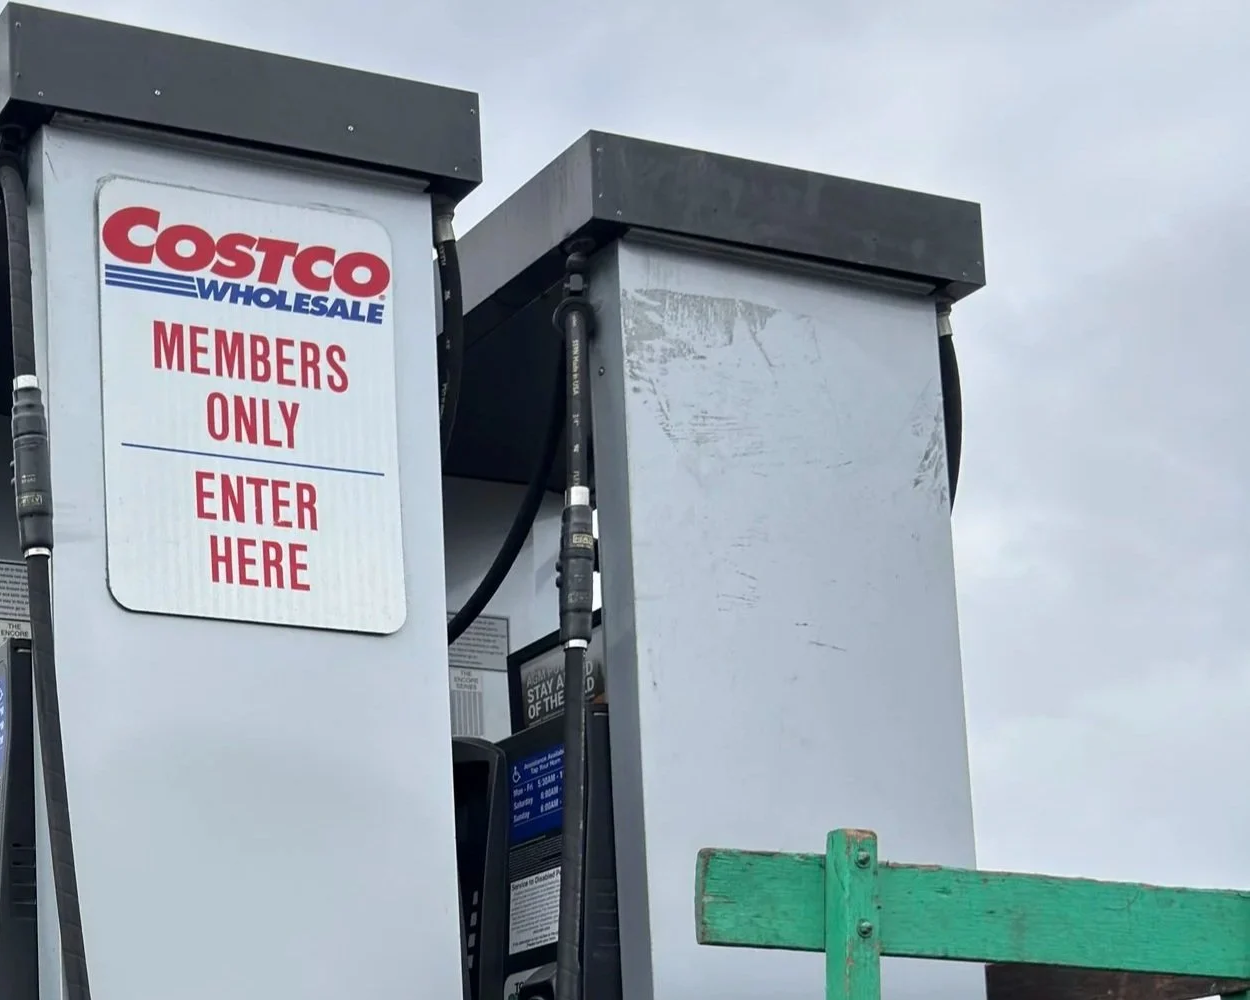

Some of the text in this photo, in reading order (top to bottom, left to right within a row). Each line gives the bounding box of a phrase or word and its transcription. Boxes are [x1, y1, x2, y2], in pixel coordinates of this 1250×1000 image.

[102, 206, 391, 298] COSTCO
[196, 277, 385, 325] WHOLESALE
[153, 320, 349, 393] MEMBERS
[207, 392, 300, 449] ONLY
[195, 471, 318, 531] ENTER
[210, 535, 311, 592] HERE
[527, 678, 554, 704] STAY
[528, 690, 565, 720] OF THE
[513, 797, 534, 811] Saturday
[513, 811, 530, 824] Sunday
[511, 880, 529, 892] Service
[534, 871, 556, 885] Disabled
